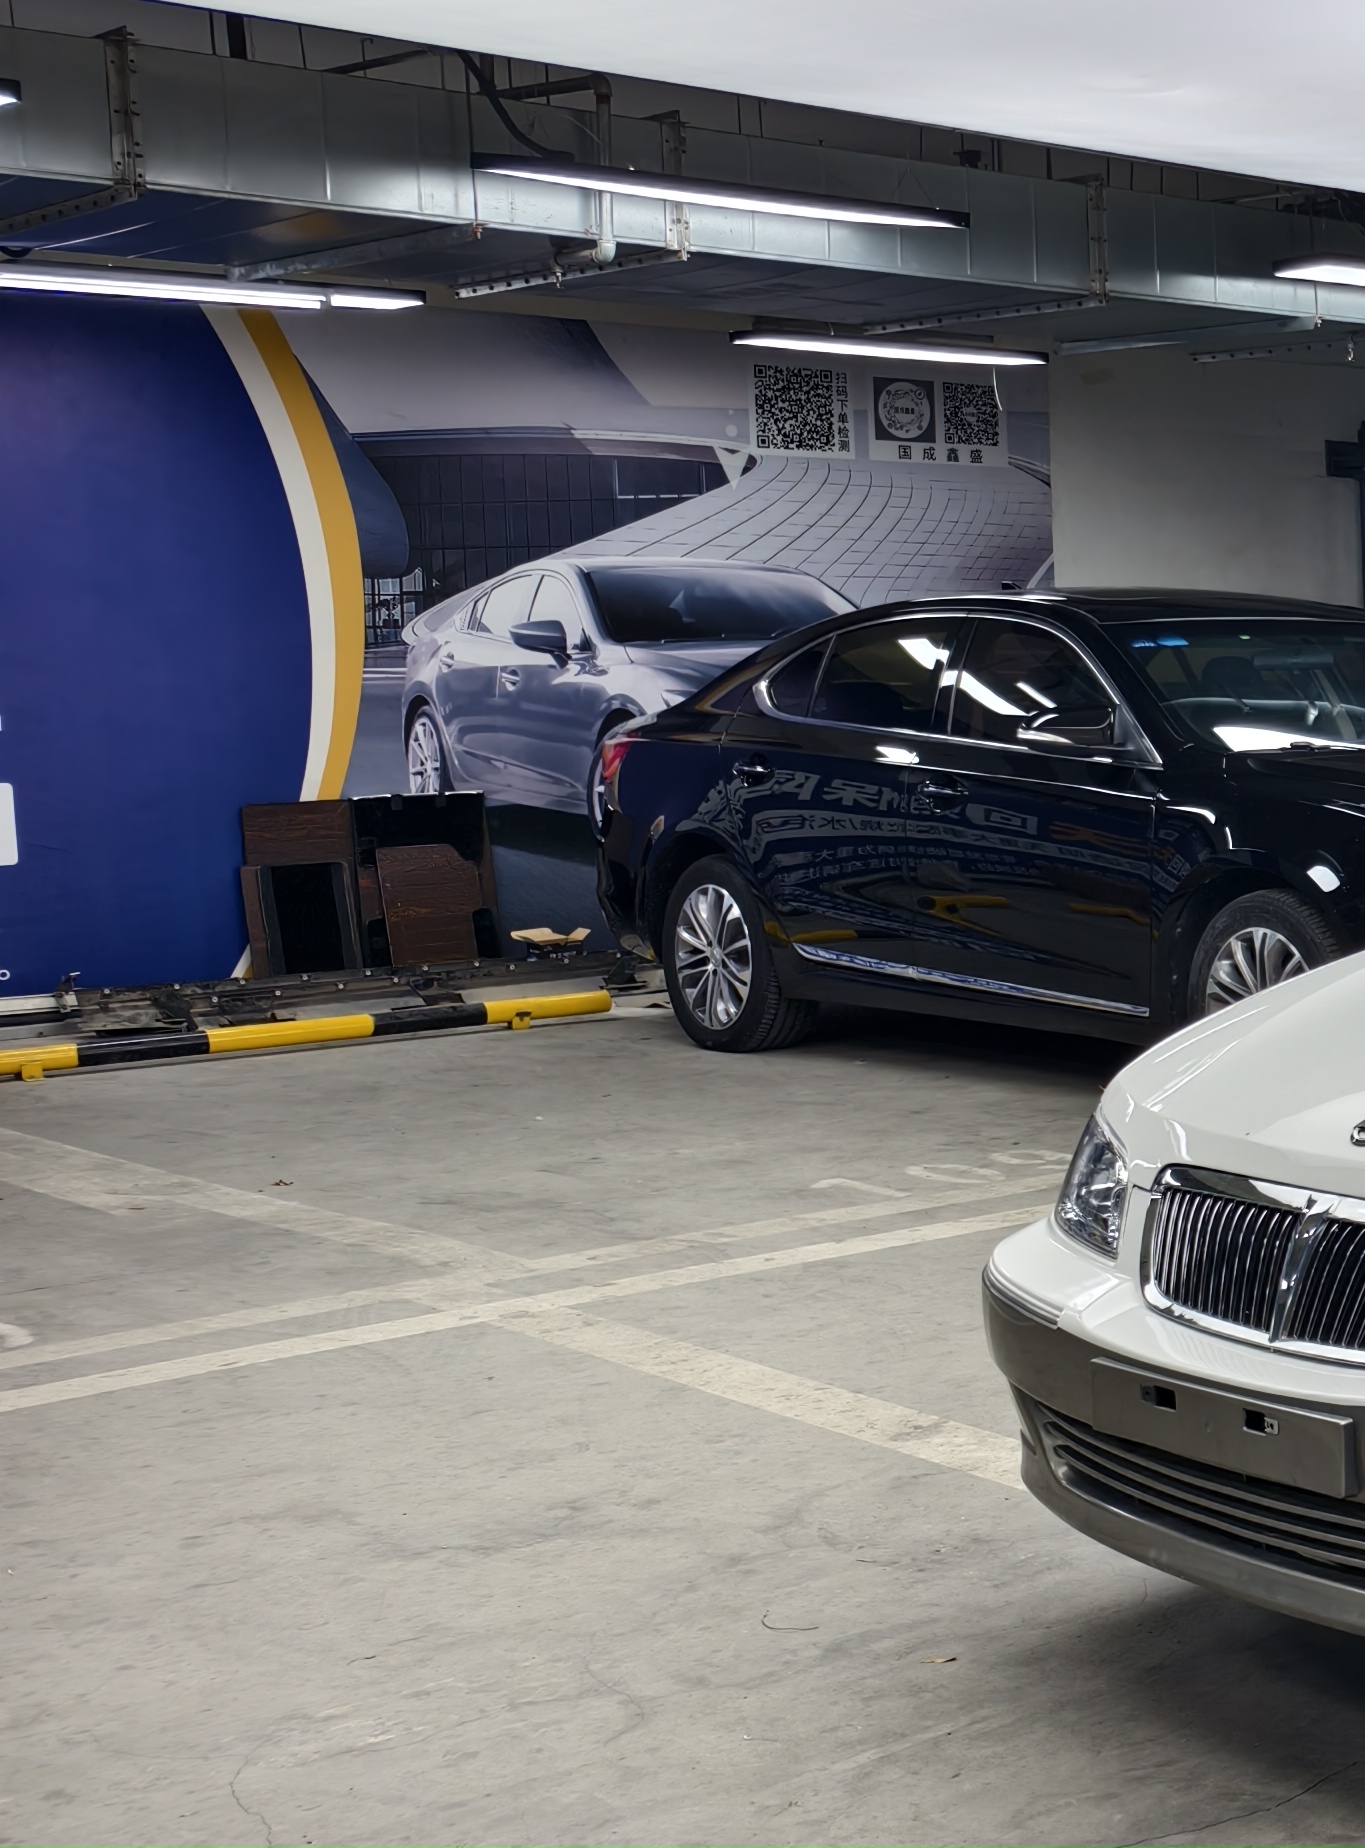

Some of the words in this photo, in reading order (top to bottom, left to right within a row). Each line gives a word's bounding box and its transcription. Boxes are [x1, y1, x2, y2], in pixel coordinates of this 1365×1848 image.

[835, 372, 850, 453] 扫码下单检测
[898, 444, 984, 464] 国成鑫盛
